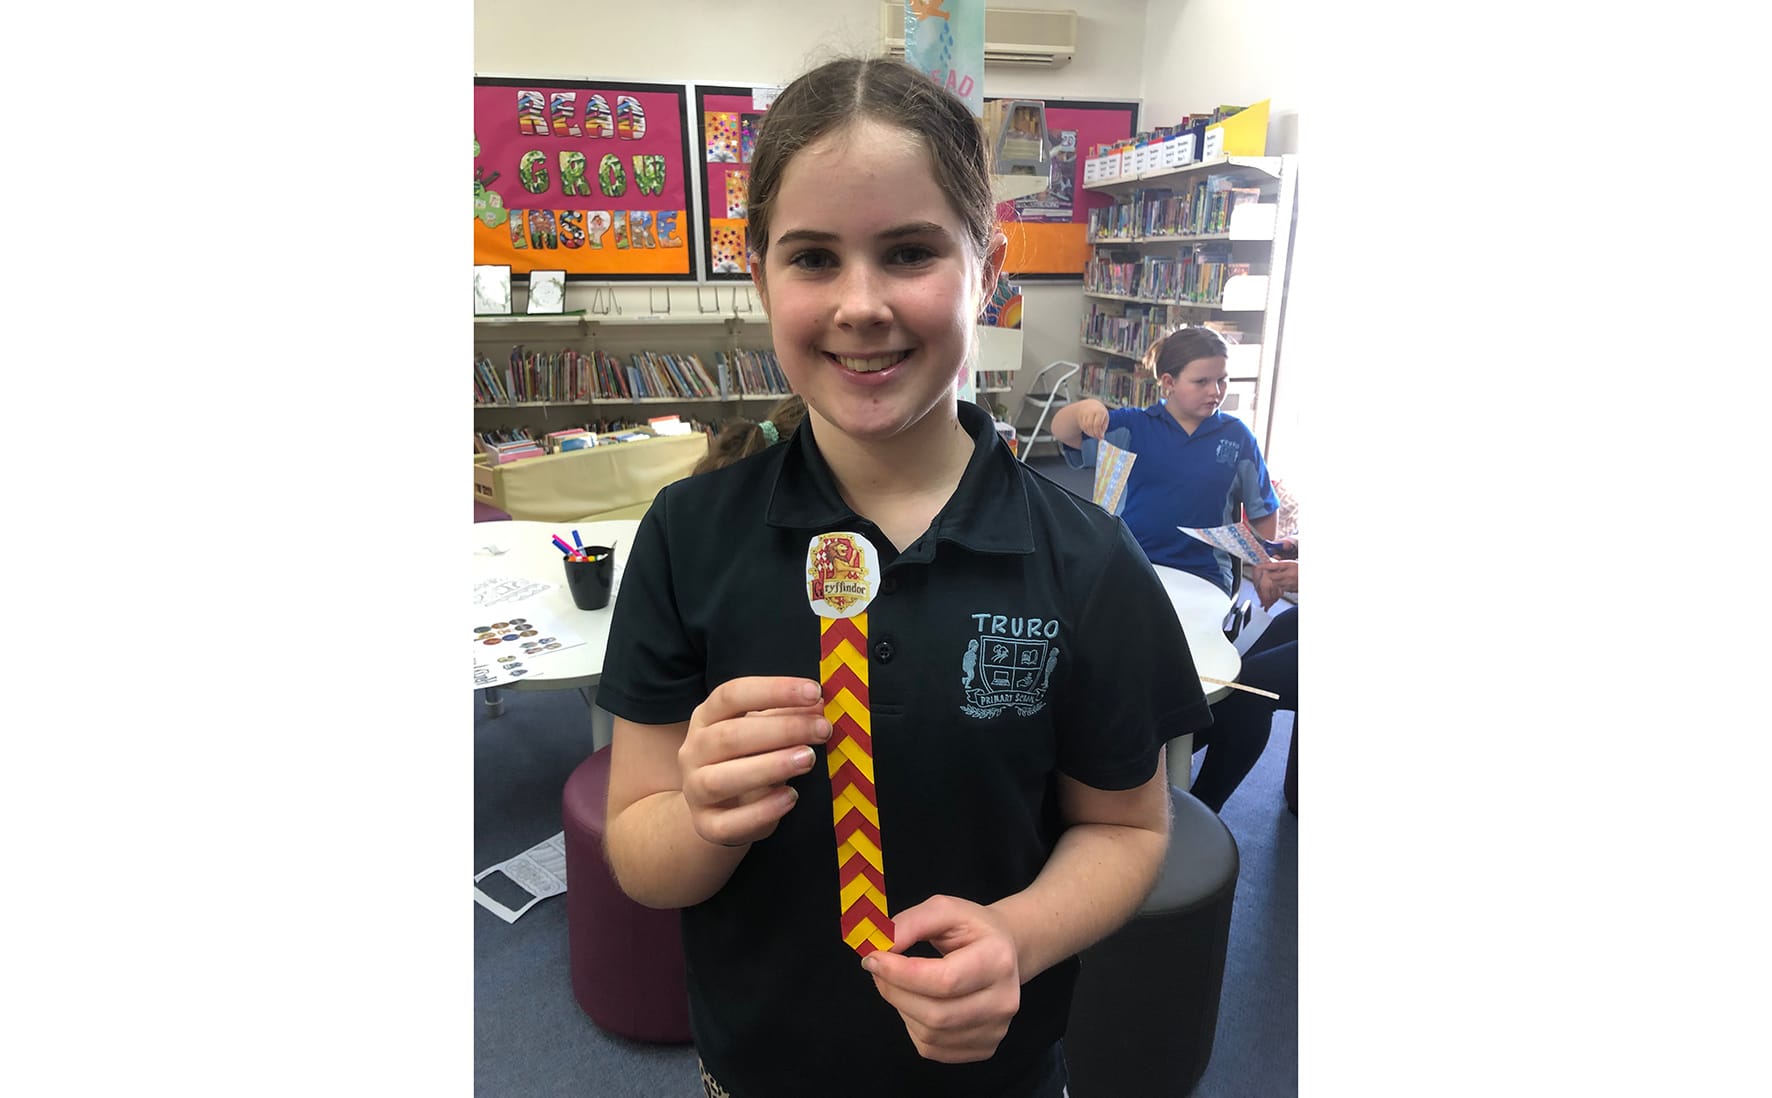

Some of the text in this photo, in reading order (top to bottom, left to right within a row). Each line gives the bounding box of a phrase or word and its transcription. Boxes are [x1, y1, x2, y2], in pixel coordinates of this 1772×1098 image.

[930, 69, 975, 97] EAD
[517, 90, 647, 140] READ
[519, 150, 666, 197] GROW
[509, 209, 683, 249] INSPIRE
[814, 580, 866, 599] Gryffindor
[971, 613, 1059, 639] TRURO
[980, 694, 1013, 706] PRIMARY
